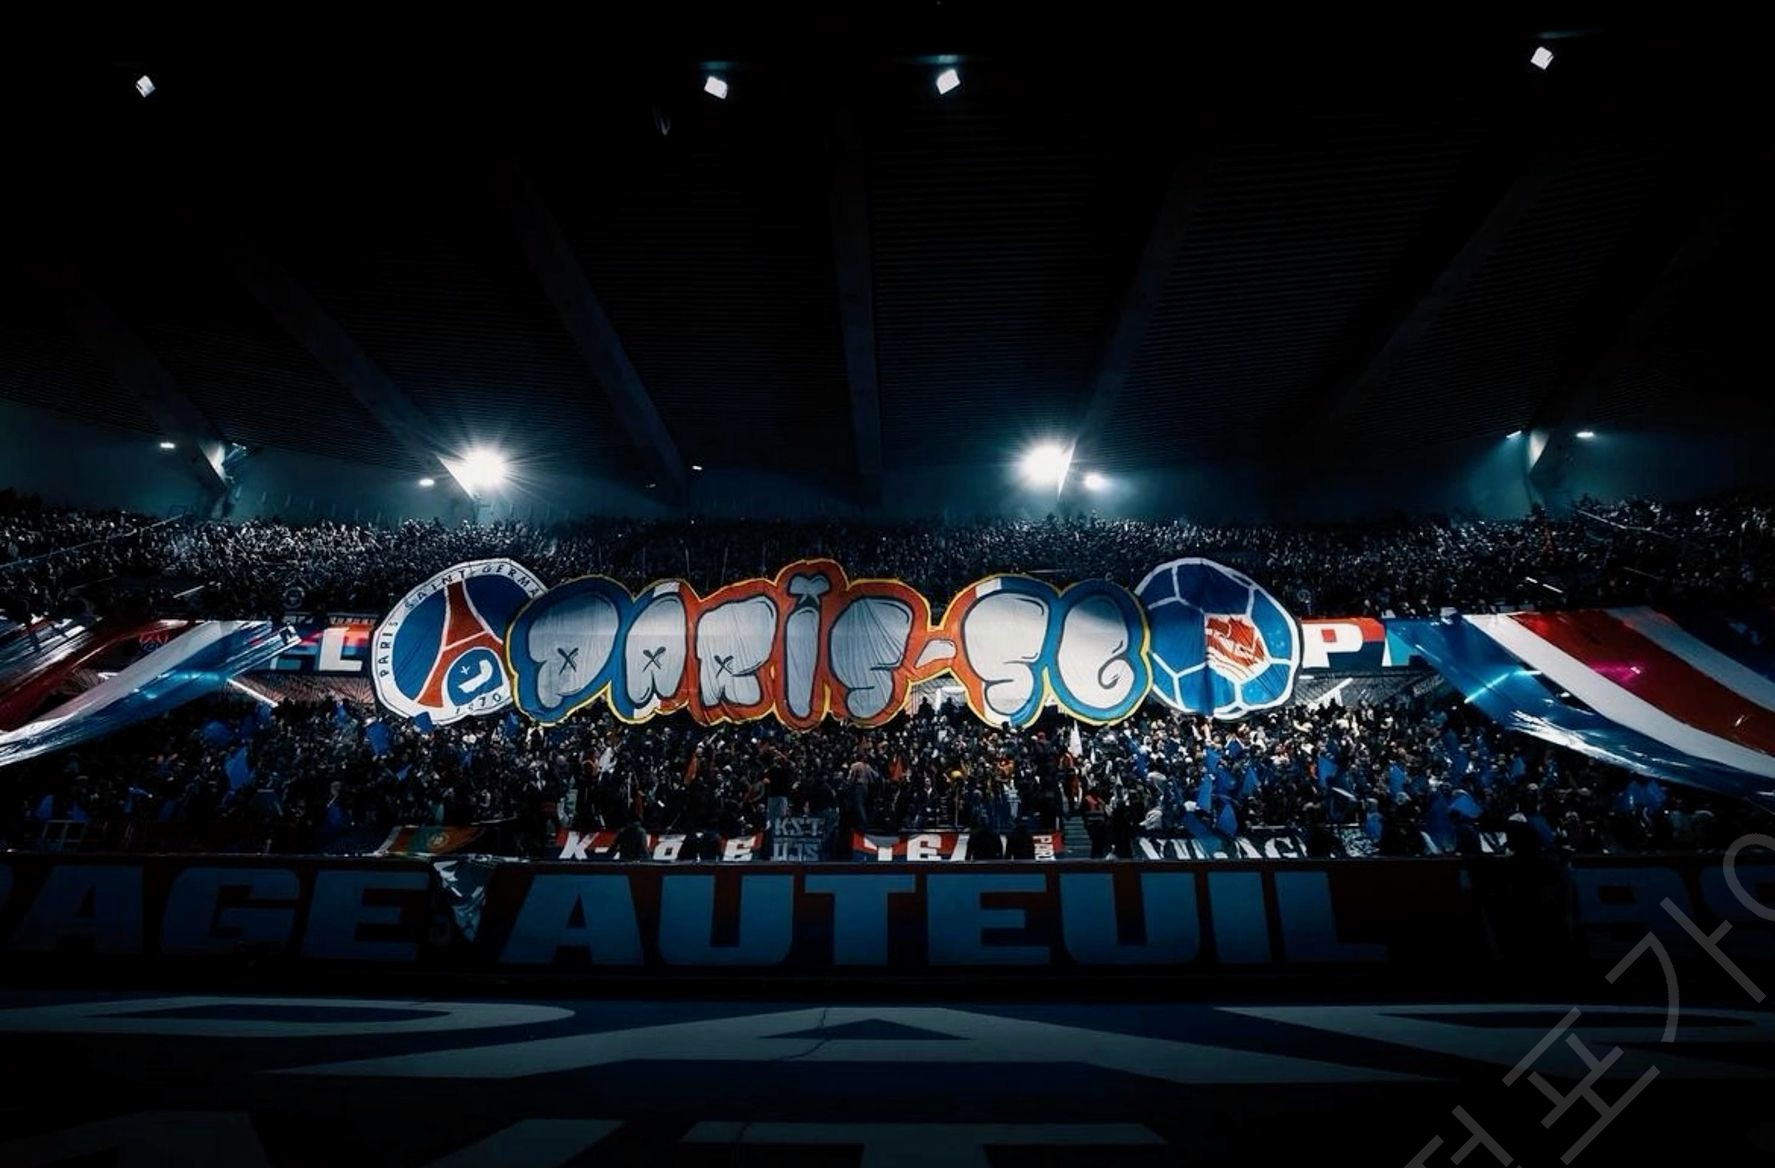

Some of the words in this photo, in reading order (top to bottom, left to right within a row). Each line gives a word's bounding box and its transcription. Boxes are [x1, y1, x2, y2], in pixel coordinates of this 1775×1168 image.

[378, 621, 398, 678] PARIS
[0, 862, 431, 963] AGE
[496, 870, 1391, 967] AUTEUIL
